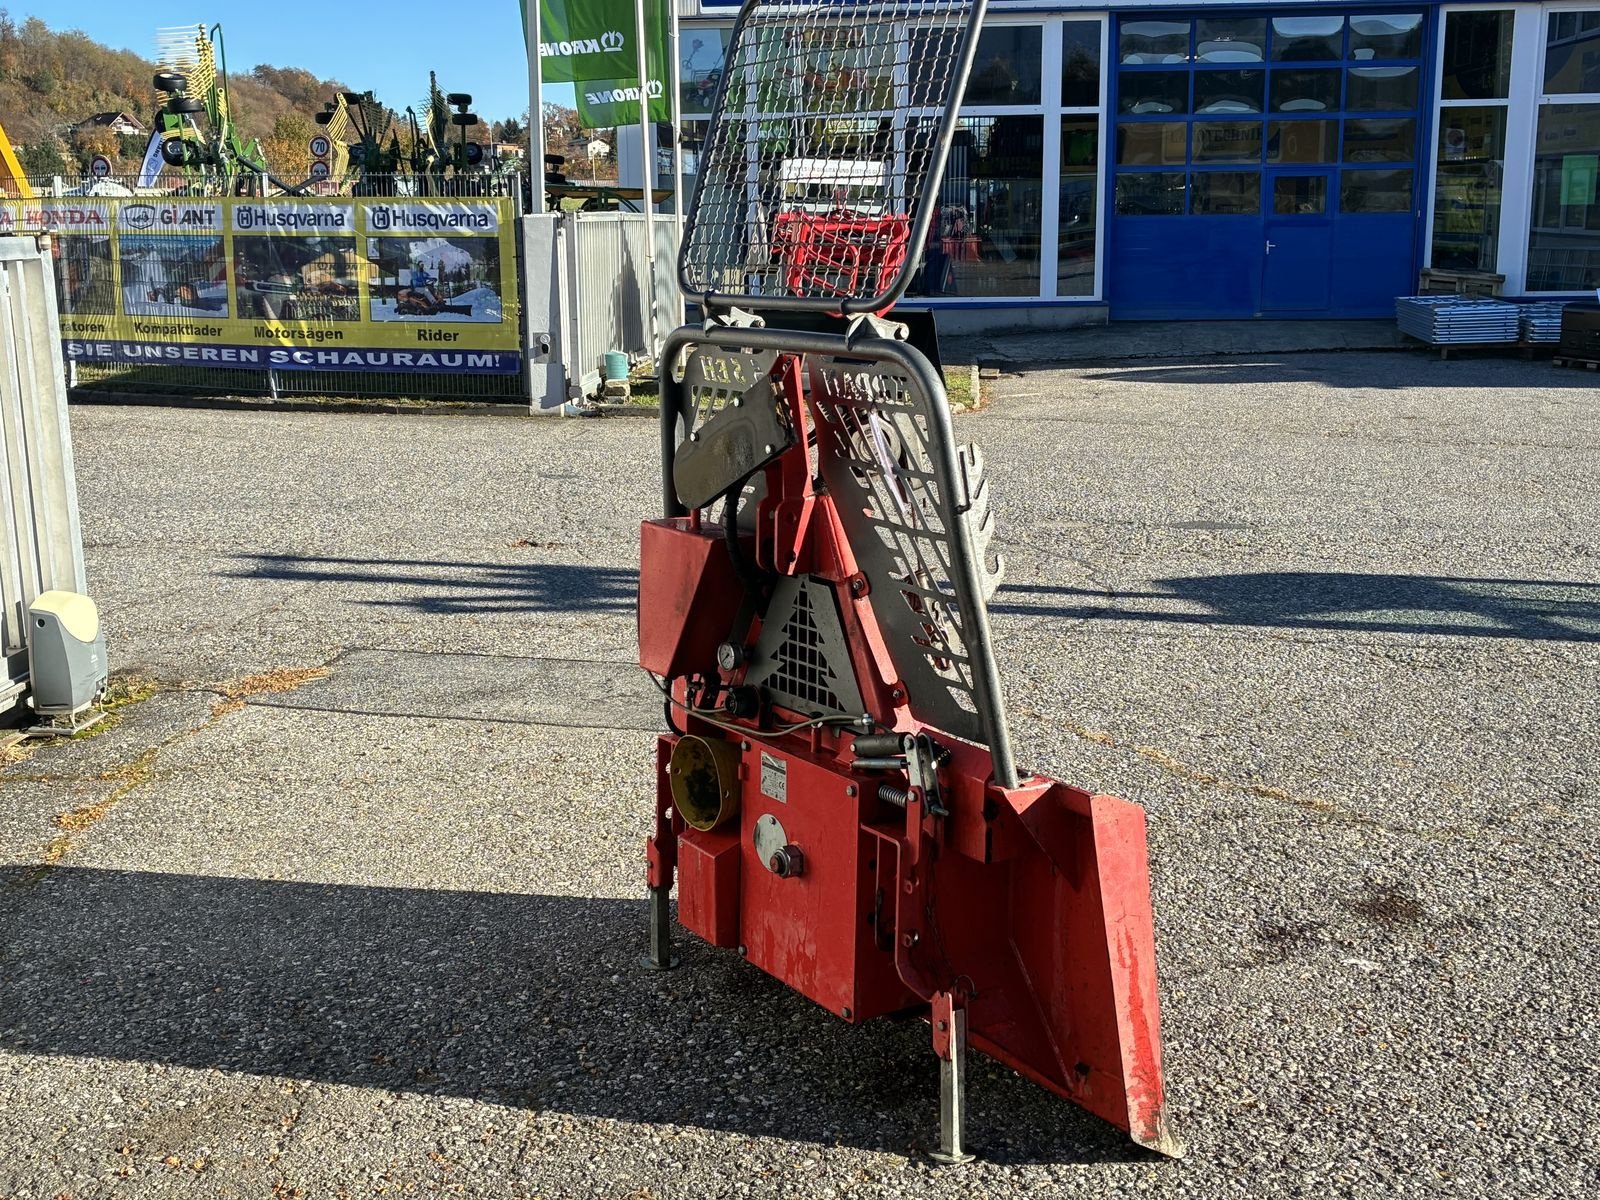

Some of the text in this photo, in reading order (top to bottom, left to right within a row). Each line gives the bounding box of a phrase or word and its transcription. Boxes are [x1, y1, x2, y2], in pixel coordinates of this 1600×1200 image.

[315, 142, 325, 152] 70
[26, 209, 104, 225] HONDA
[254, 208, 345, 229] Husqvarna
[392, 208, 488, 230] Husqvarna
[134, 321, 223, 337] Kompaktlader
[254, 326, 344, 343] Motorsägen
[417, 329, 459, 342] Rider
[67, 343, 500, 368] SIE UNSEREN SCHAURAUM!
